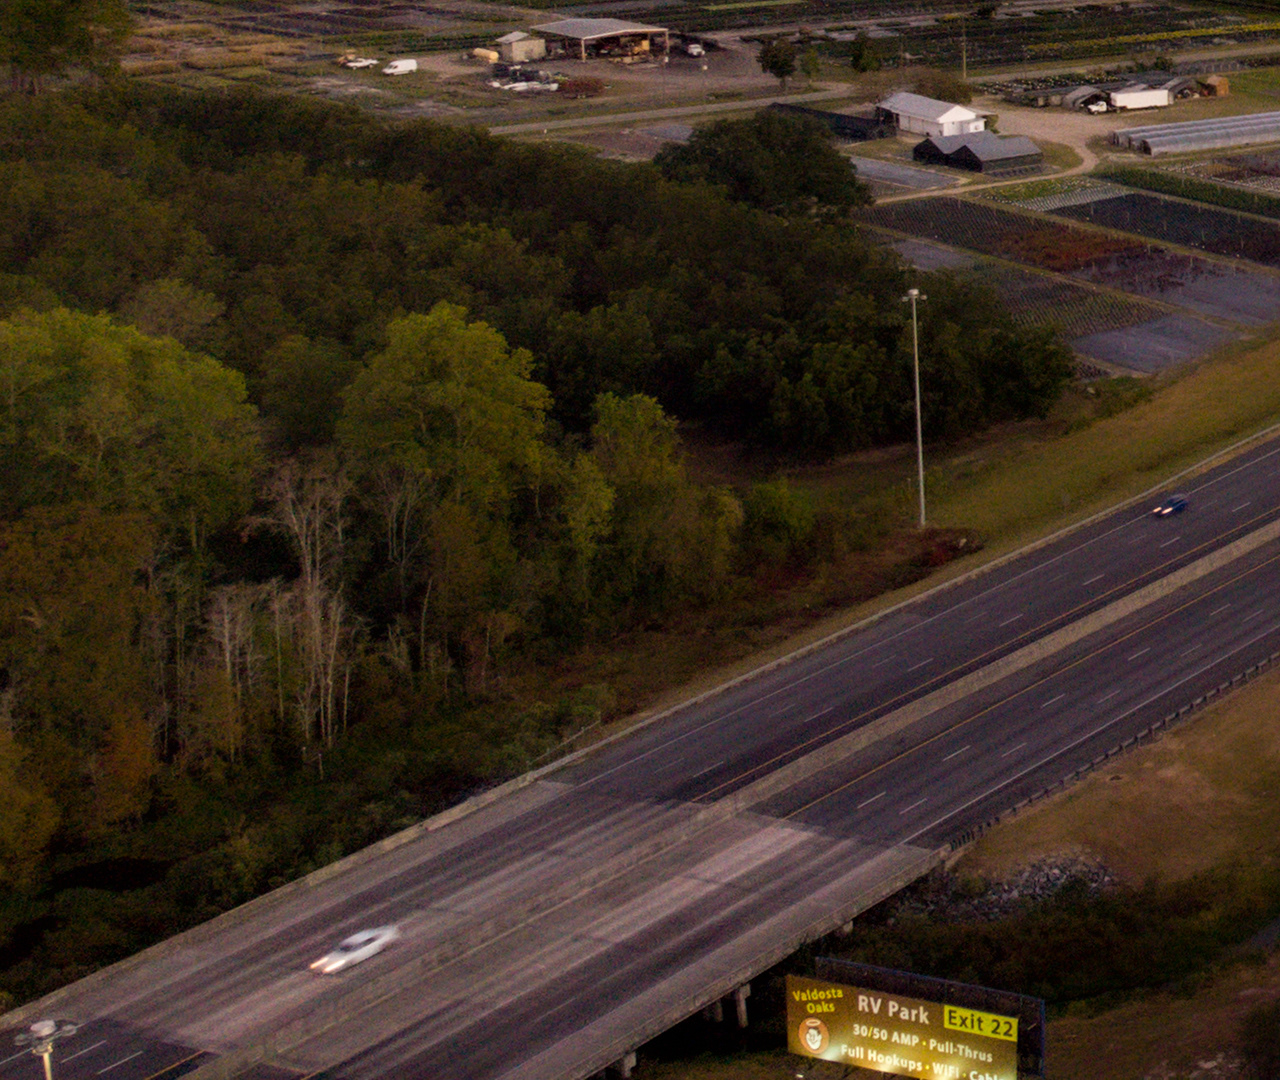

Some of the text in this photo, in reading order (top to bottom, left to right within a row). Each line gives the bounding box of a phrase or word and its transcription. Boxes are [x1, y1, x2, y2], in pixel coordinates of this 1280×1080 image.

[792, 988, 844, 1002] Valdosta
[806, 1001, 836, 1014] Oaks
[858, 995, 930, 1025] RV Park
[948, 1009, 1013, 1037] Exit 22
[853, 1024, 994, 1063] 30/50 AMP Pull-Thrus
[841, 1044, 864, 1059] Full
[867, 1049, 923, 1072] Hookups
[970, 1070, 1004, 1080] Cabl
